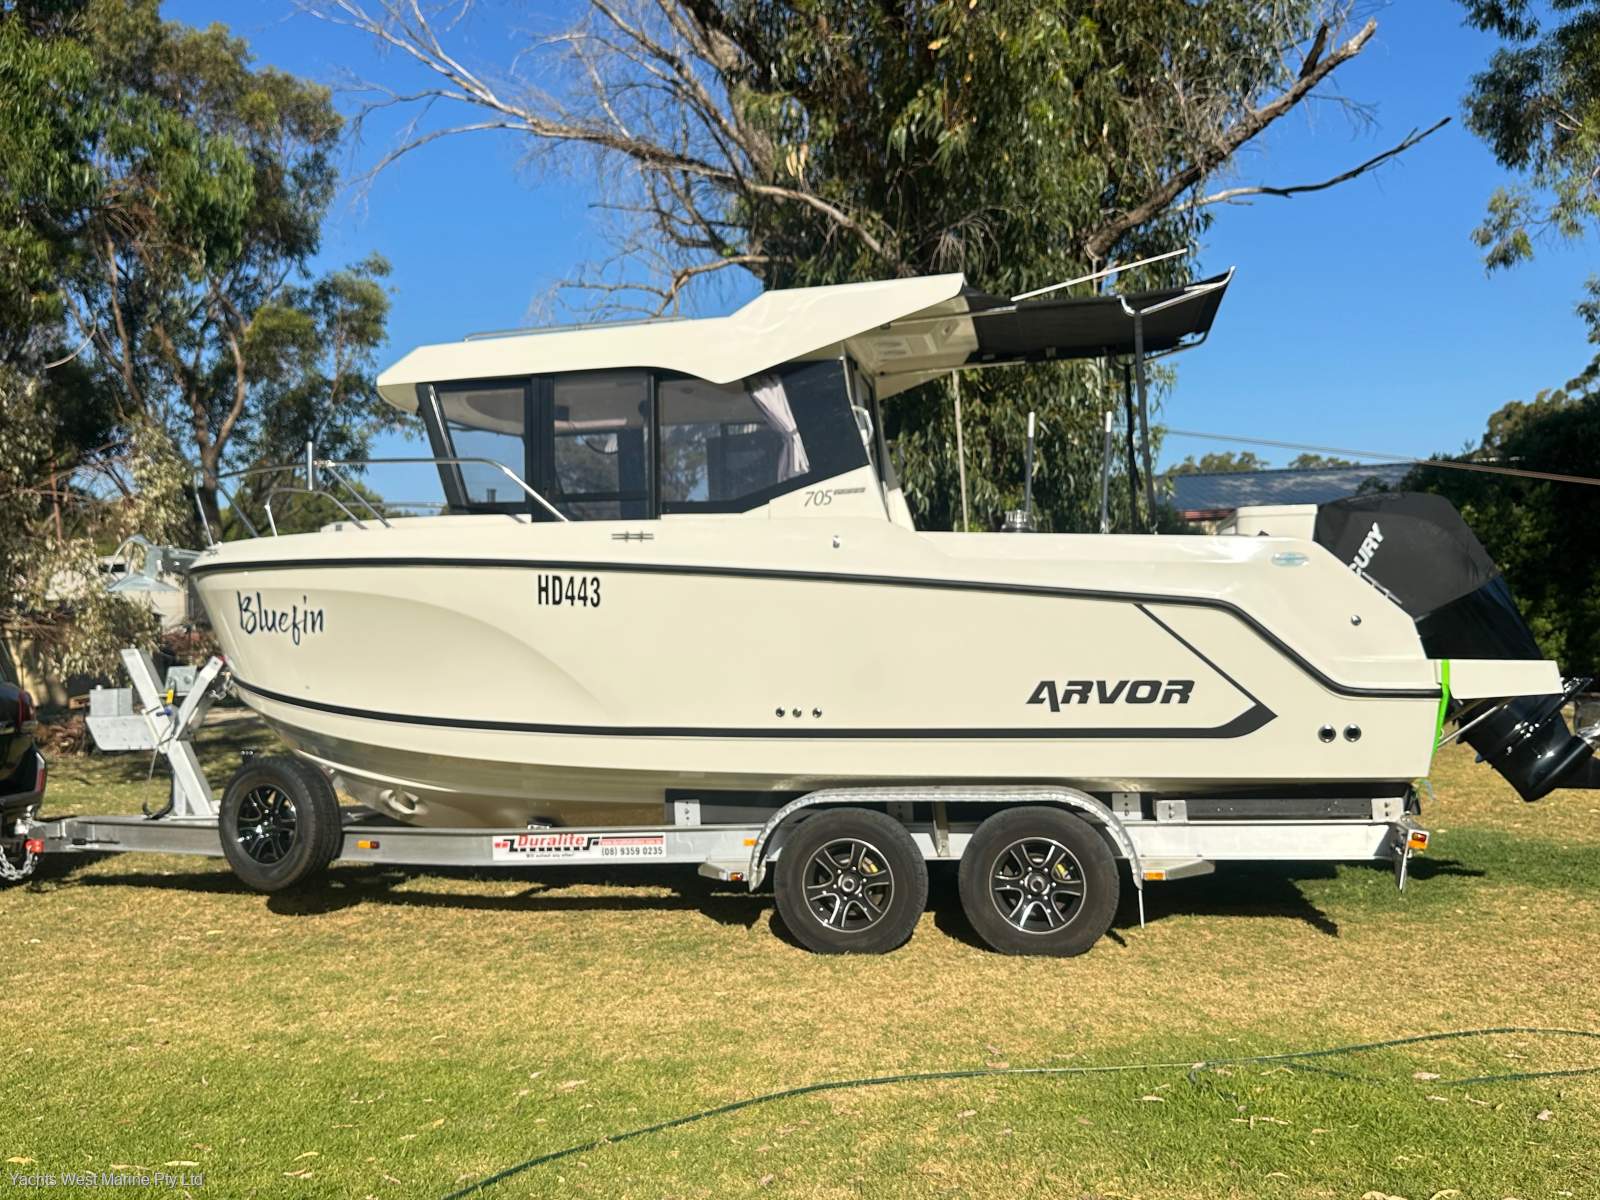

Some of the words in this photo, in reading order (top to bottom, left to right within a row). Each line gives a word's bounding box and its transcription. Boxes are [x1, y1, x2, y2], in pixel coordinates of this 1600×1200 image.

[804, 489, 832, 507] 705
[537, 574, 600, 607] HD443
[236, 590, 323, 646] Bluefin
[1026, 680, 1195, 712] ARVOR
[518, 833, 585, 846] Duralite
[601, 847, 618, 856] (08)
[620, 847, 640, 855] 9359
[642, 846, 663, 855] 0235
